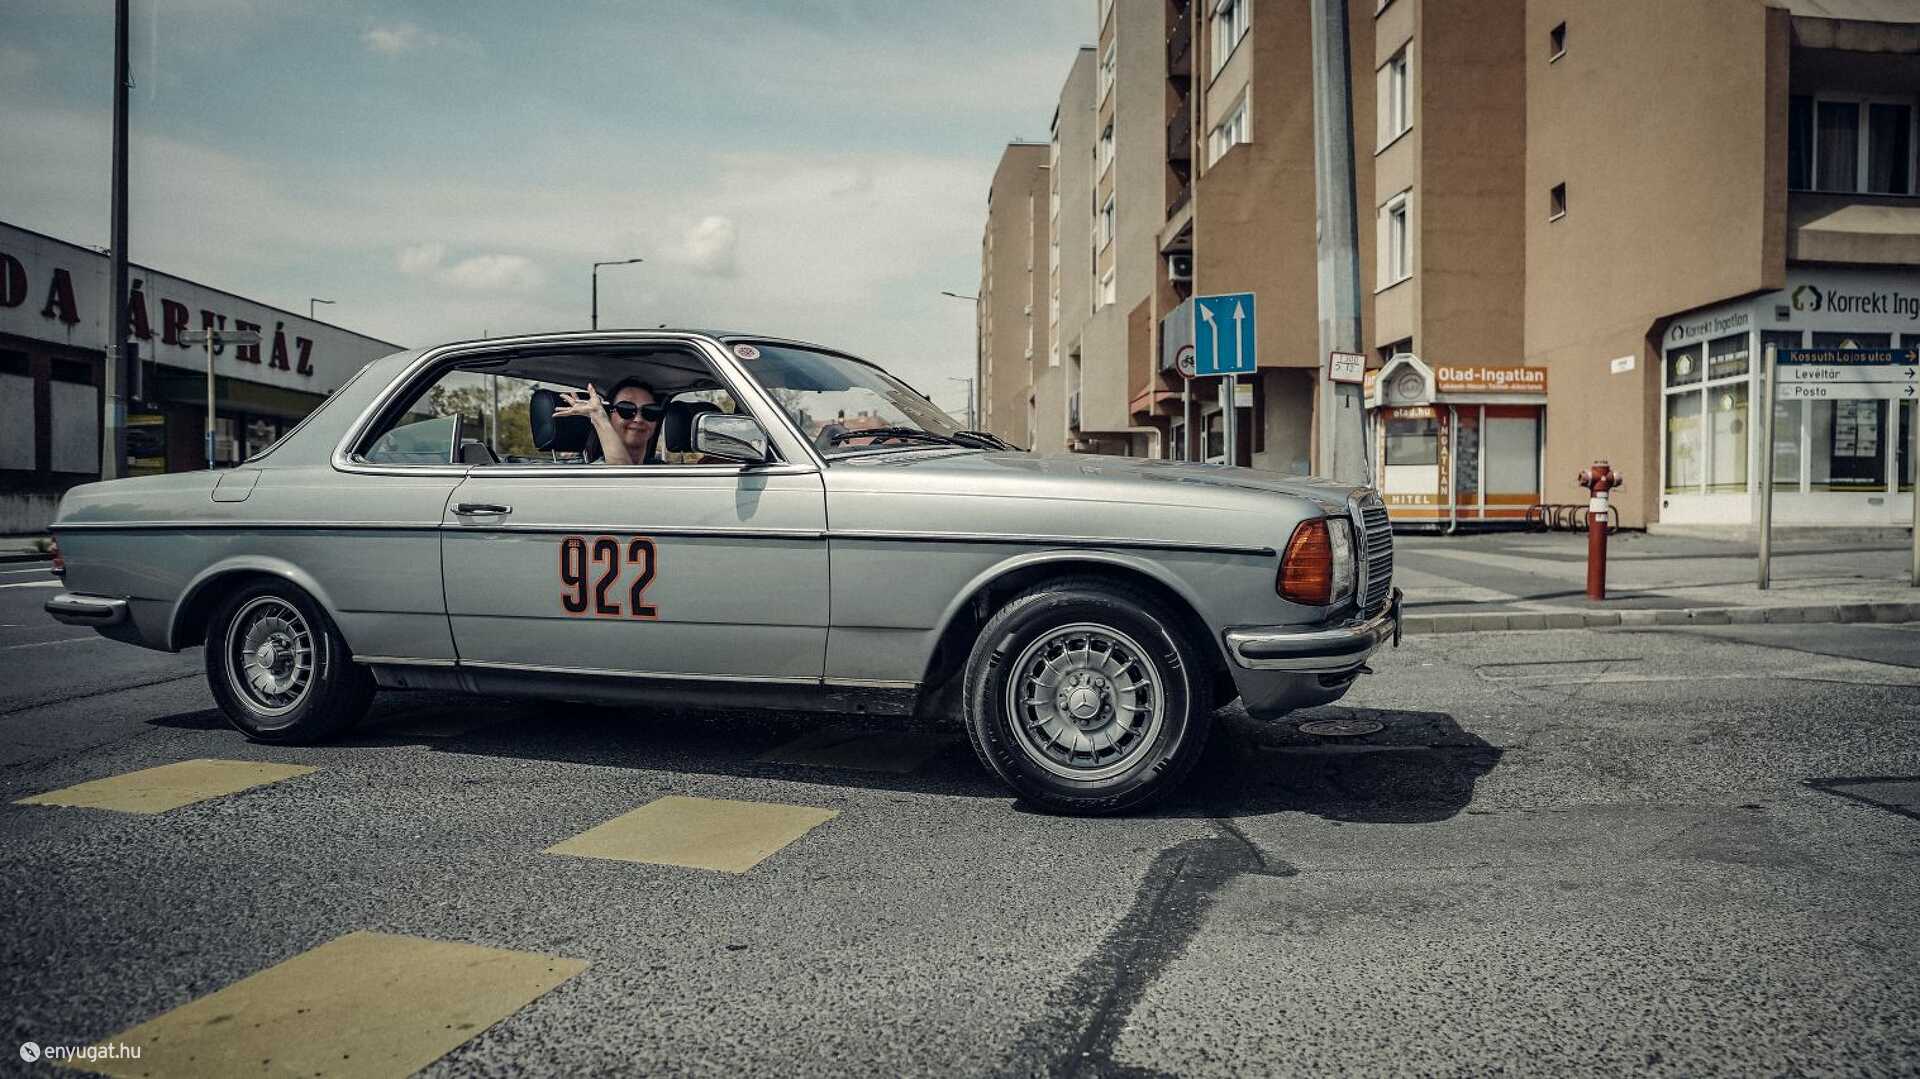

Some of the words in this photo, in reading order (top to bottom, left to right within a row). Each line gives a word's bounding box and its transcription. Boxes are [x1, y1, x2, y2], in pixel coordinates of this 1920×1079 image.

[1827, 290, 1888, 314] Korrekt
[1685, 321, 1712, 337] Korrekt
[1714, 313, 1748, 333] Ingatlan
[1790, 351, 1835, 362] Kossuth
[1868, 351, 1892, 362] utca
[1438, 367, 1544, 383] Olad-Ingatlan
[1795, 386, 1827, 397] Posta
[1393, 406, 1431, 418] olad.hu
[1440, 416, 1449, 496] INGATLAN
[1391, 495, 1431, 505] HITEL
[560, 536, 658, 619] 922
